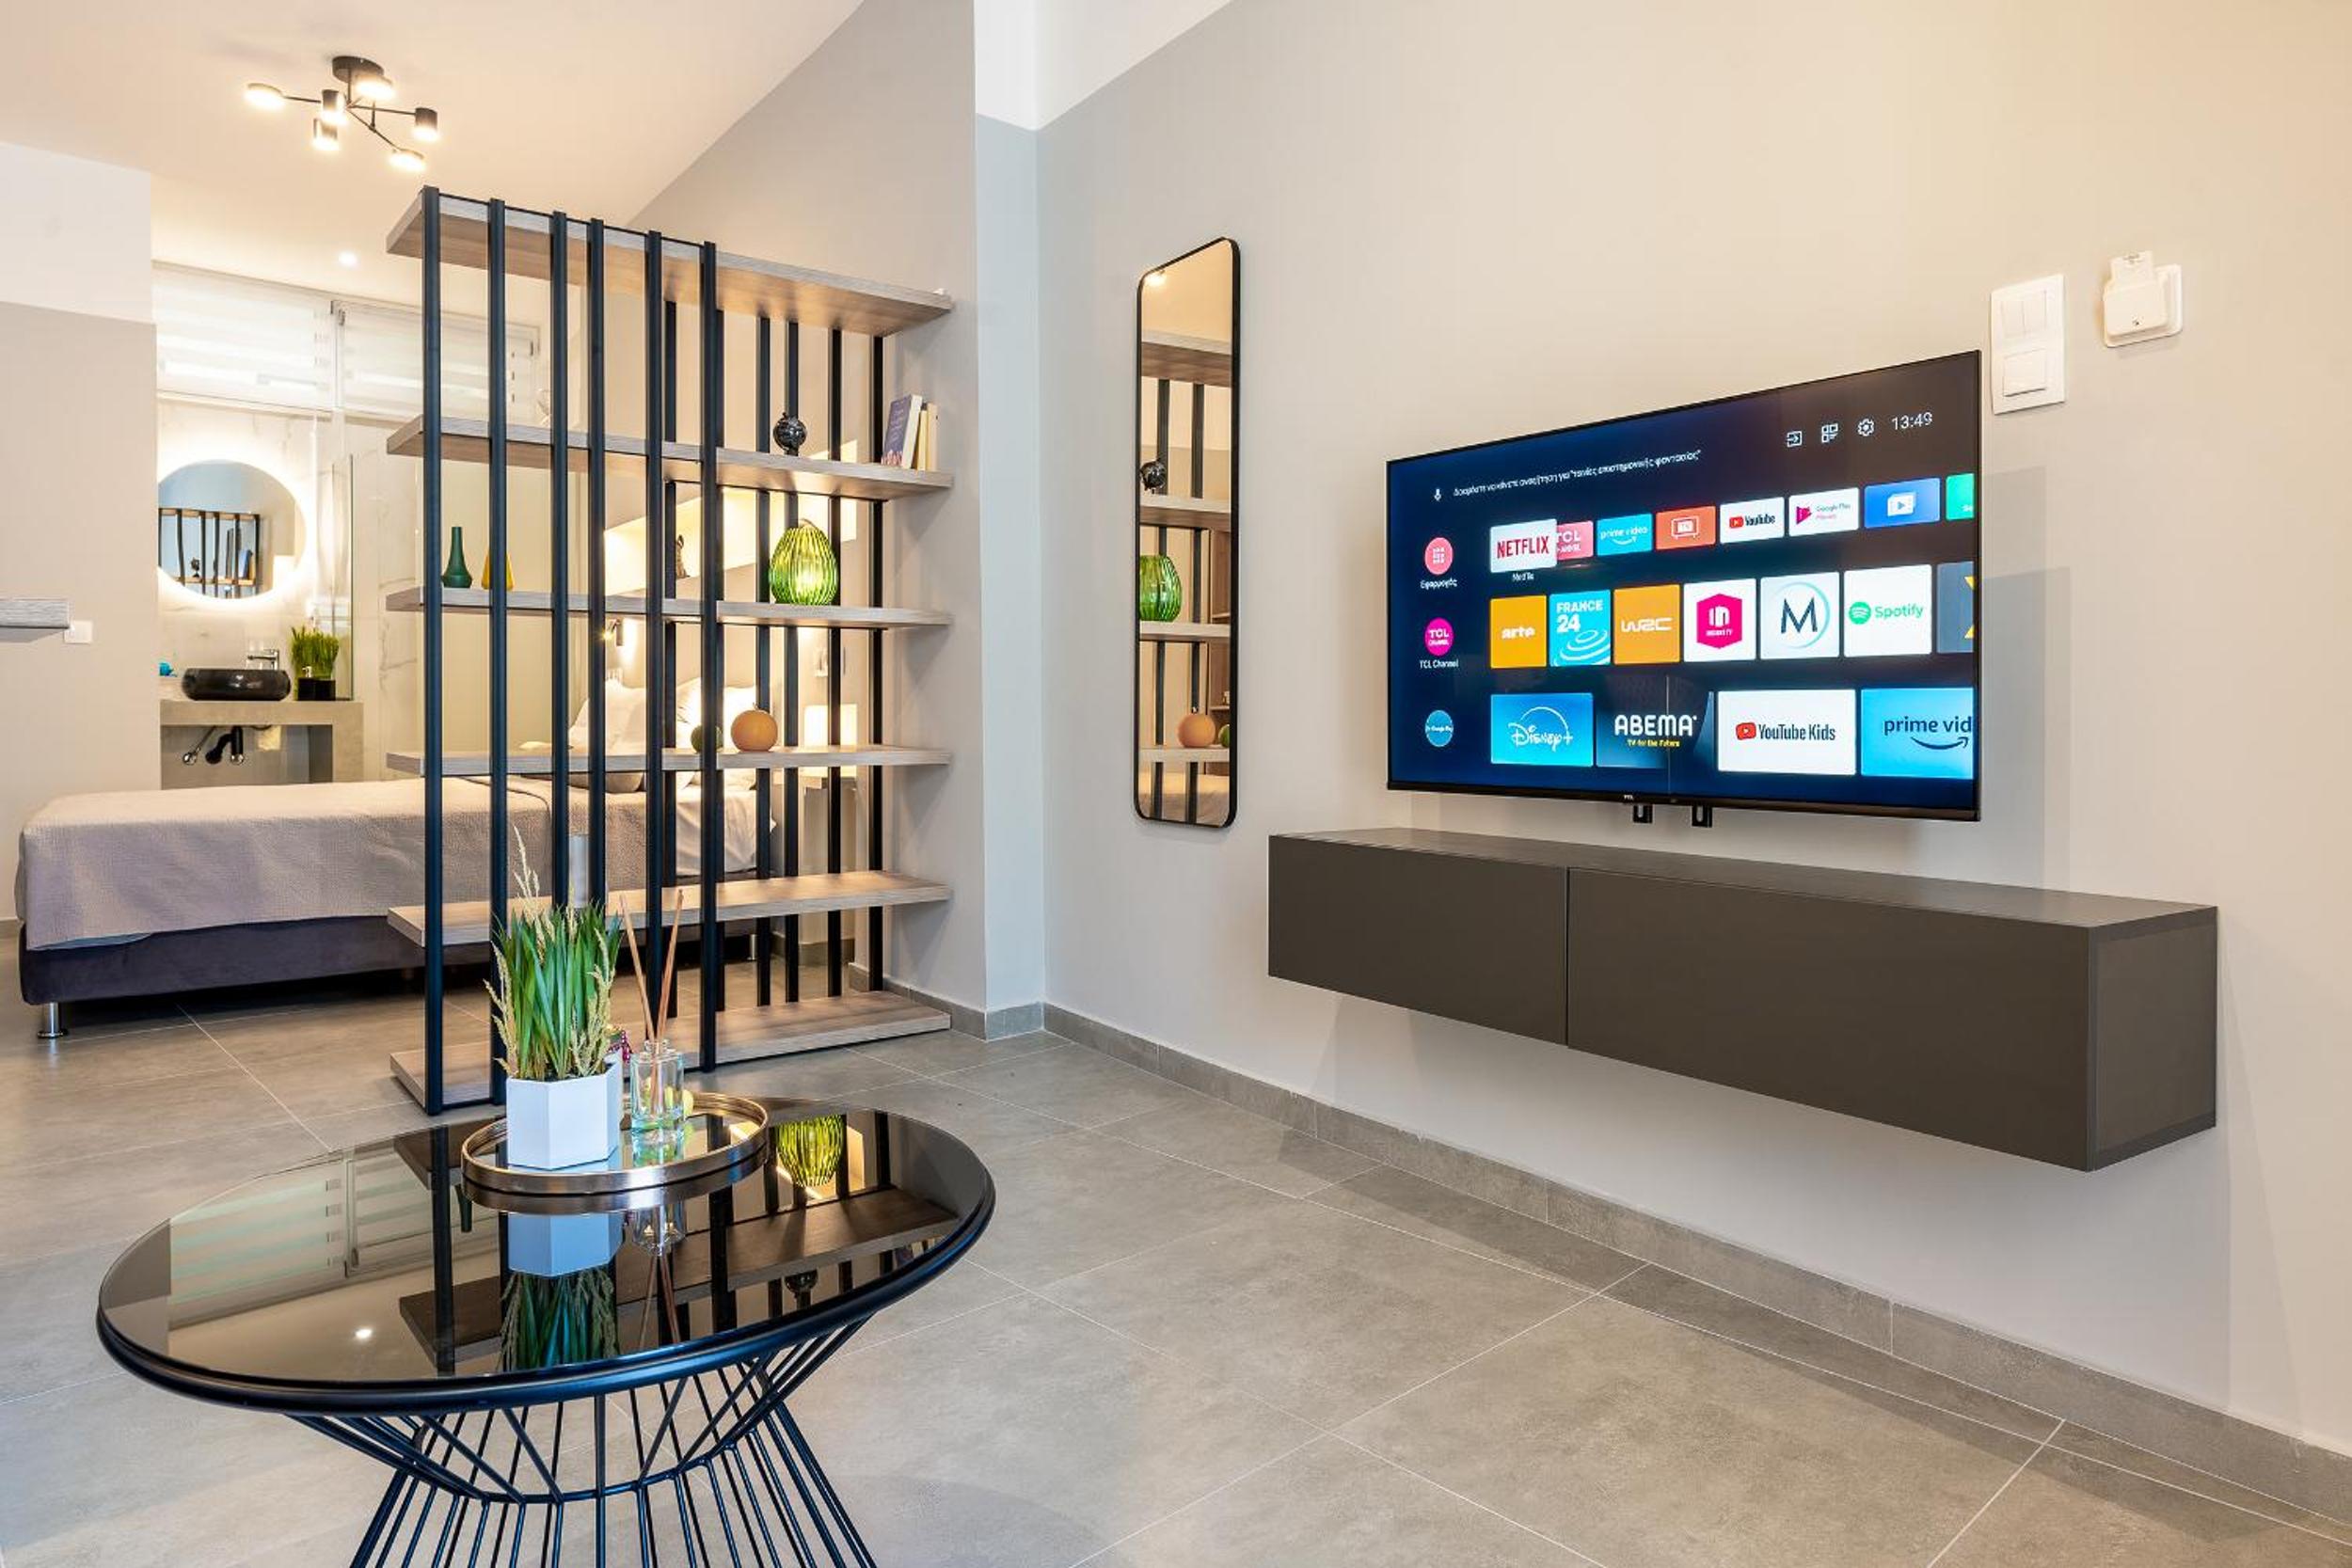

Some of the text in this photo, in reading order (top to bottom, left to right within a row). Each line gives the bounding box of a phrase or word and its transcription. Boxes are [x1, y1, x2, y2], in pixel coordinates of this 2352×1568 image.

[1892, 412, 1932, 430] 13:49
[1744, 514, 1776, 527] YouTube
[1497, 535, 1550, 560] NETFLIX
[1556, 599, 1604, 613] FRANCE
[1874, 603, 1924, 621] Spotify
[1557, 614, 1581, 634] 24
[1781, 597, 1818, 634] M
[1428, 628, 1450, 639] TCL
[1502, 626, 1535, 640] arte
[1420, 658, 1432, 669] TCL
[1614, 714, 1693, 736] ABEMA
[1758, 723, 1836, 740] YouTube Kids
[1883, 717, 1938, 736] prime
